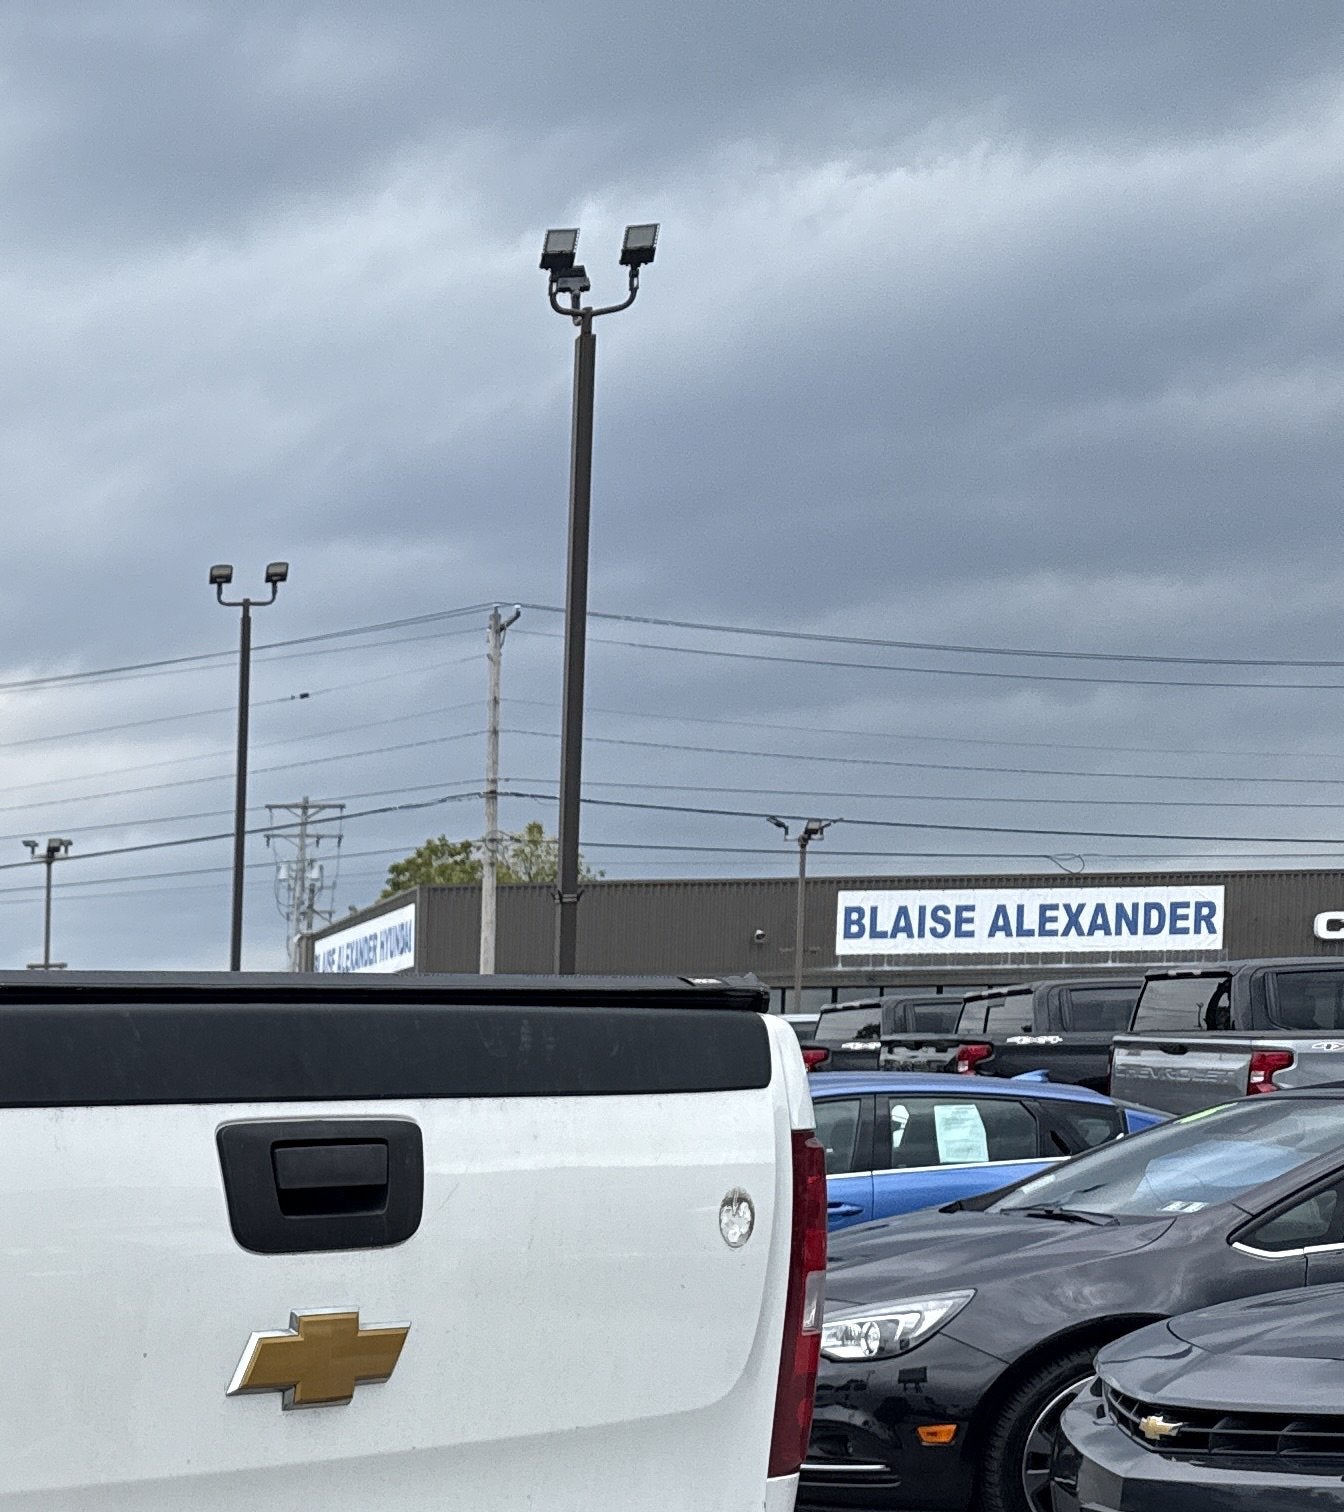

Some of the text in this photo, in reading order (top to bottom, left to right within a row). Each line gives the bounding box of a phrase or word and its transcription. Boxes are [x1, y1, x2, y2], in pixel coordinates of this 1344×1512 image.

[843, 900, 1218, 940] BLAISE ALEXANDER
[338, 932, 378, 973] ALEXANDER
[380, 919, 413, 961] HYUNDAI
